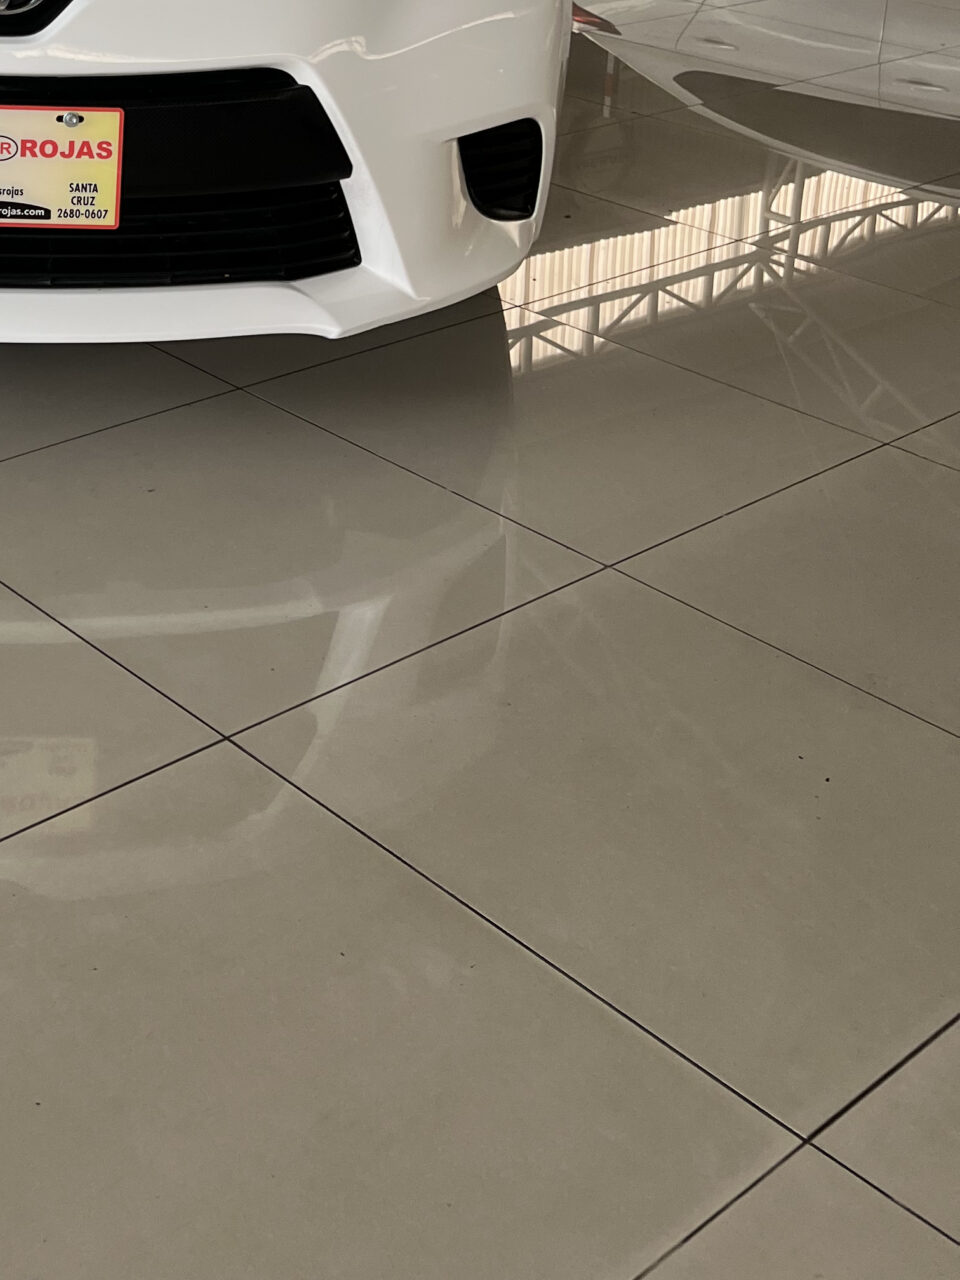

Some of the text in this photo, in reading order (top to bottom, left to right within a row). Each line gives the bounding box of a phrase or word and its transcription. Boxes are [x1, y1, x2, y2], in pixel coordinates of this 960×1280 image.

[20, 139, 113, 160] ROJAS
[69, 183, 99, 194] SANTA
[70, 196, 96, 206] CRUZ
[57, 208, 109, 219] 2680-0607
